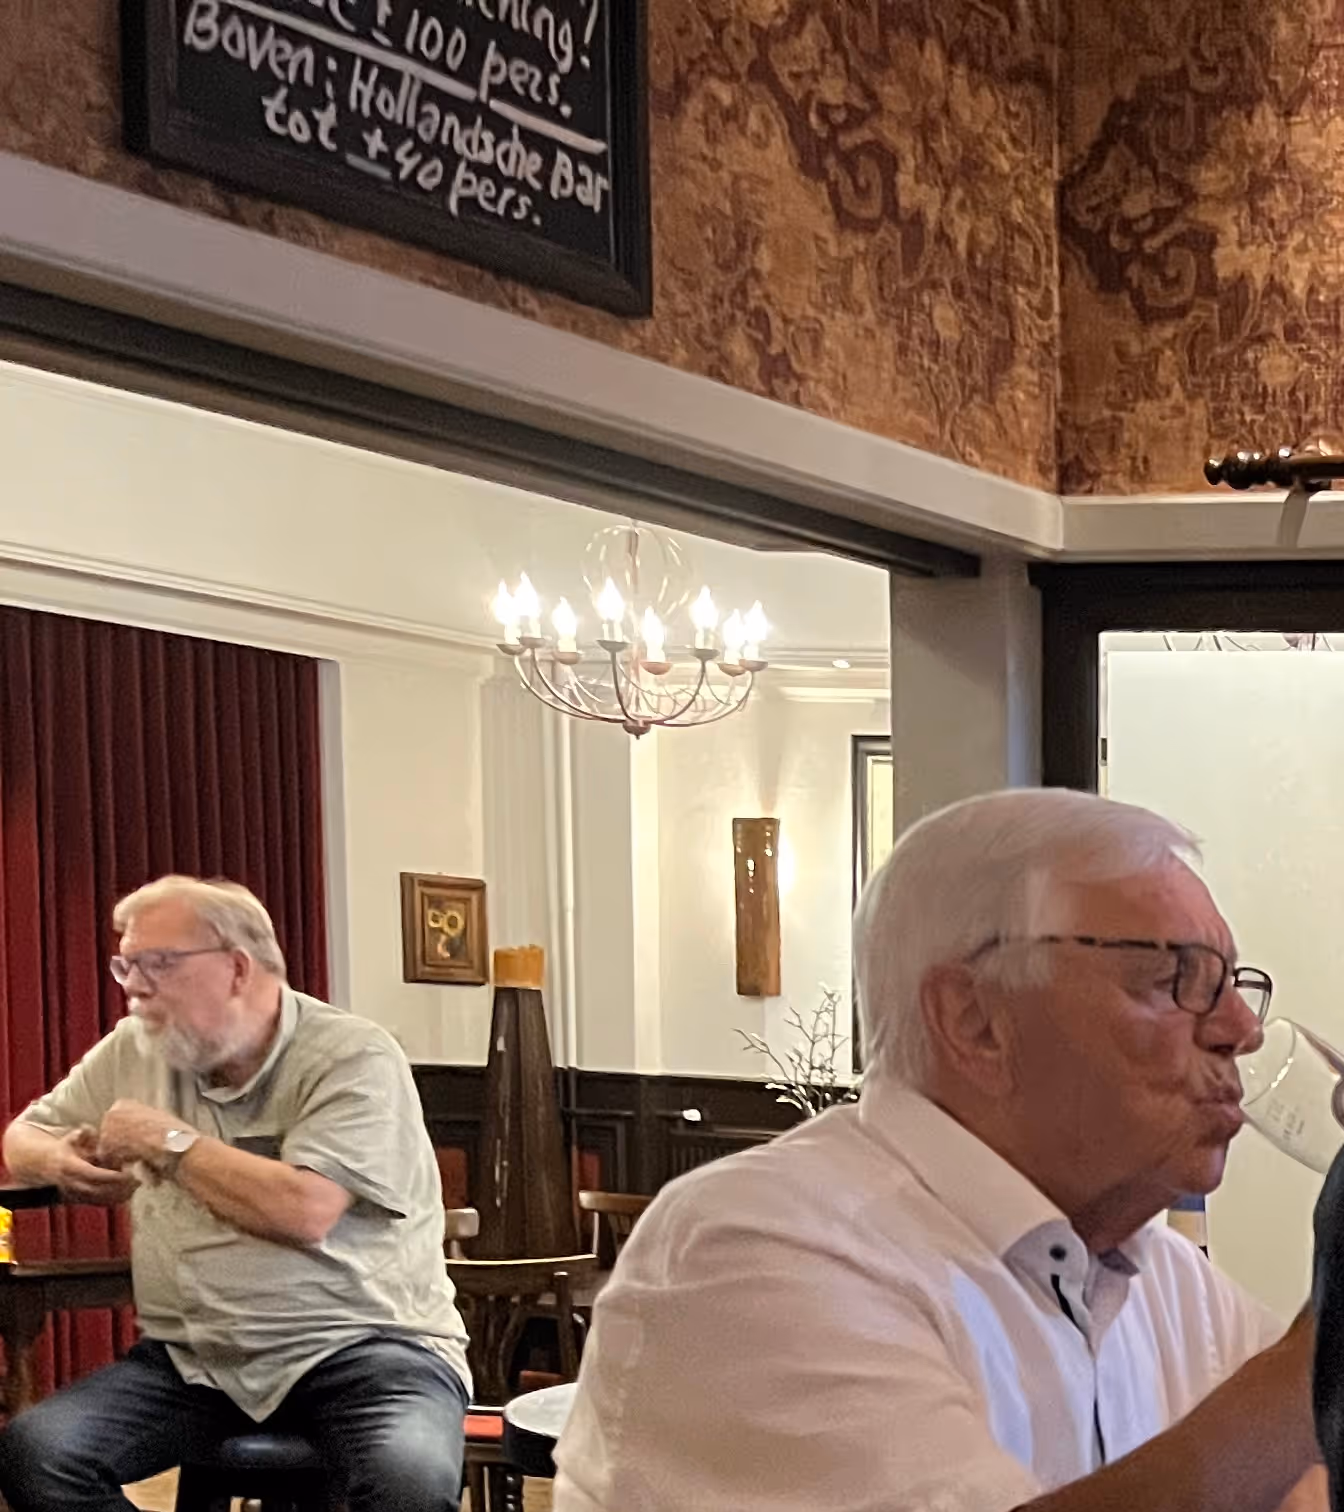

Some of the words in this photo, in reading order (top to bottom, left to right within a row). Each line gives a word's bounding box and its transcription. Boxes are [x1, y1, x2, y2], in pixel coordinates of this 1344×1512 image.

[405, 8, 467, 73] 100
[479, 39, 572, 119] pers.
[261, 86, 338, 152] tot
[394, 138, 444, 192] 40
[448, 158, 542, 227] pers.
[349, 56, 543, 191] Hollandsche
[549, 146, 612, 214] Bar
